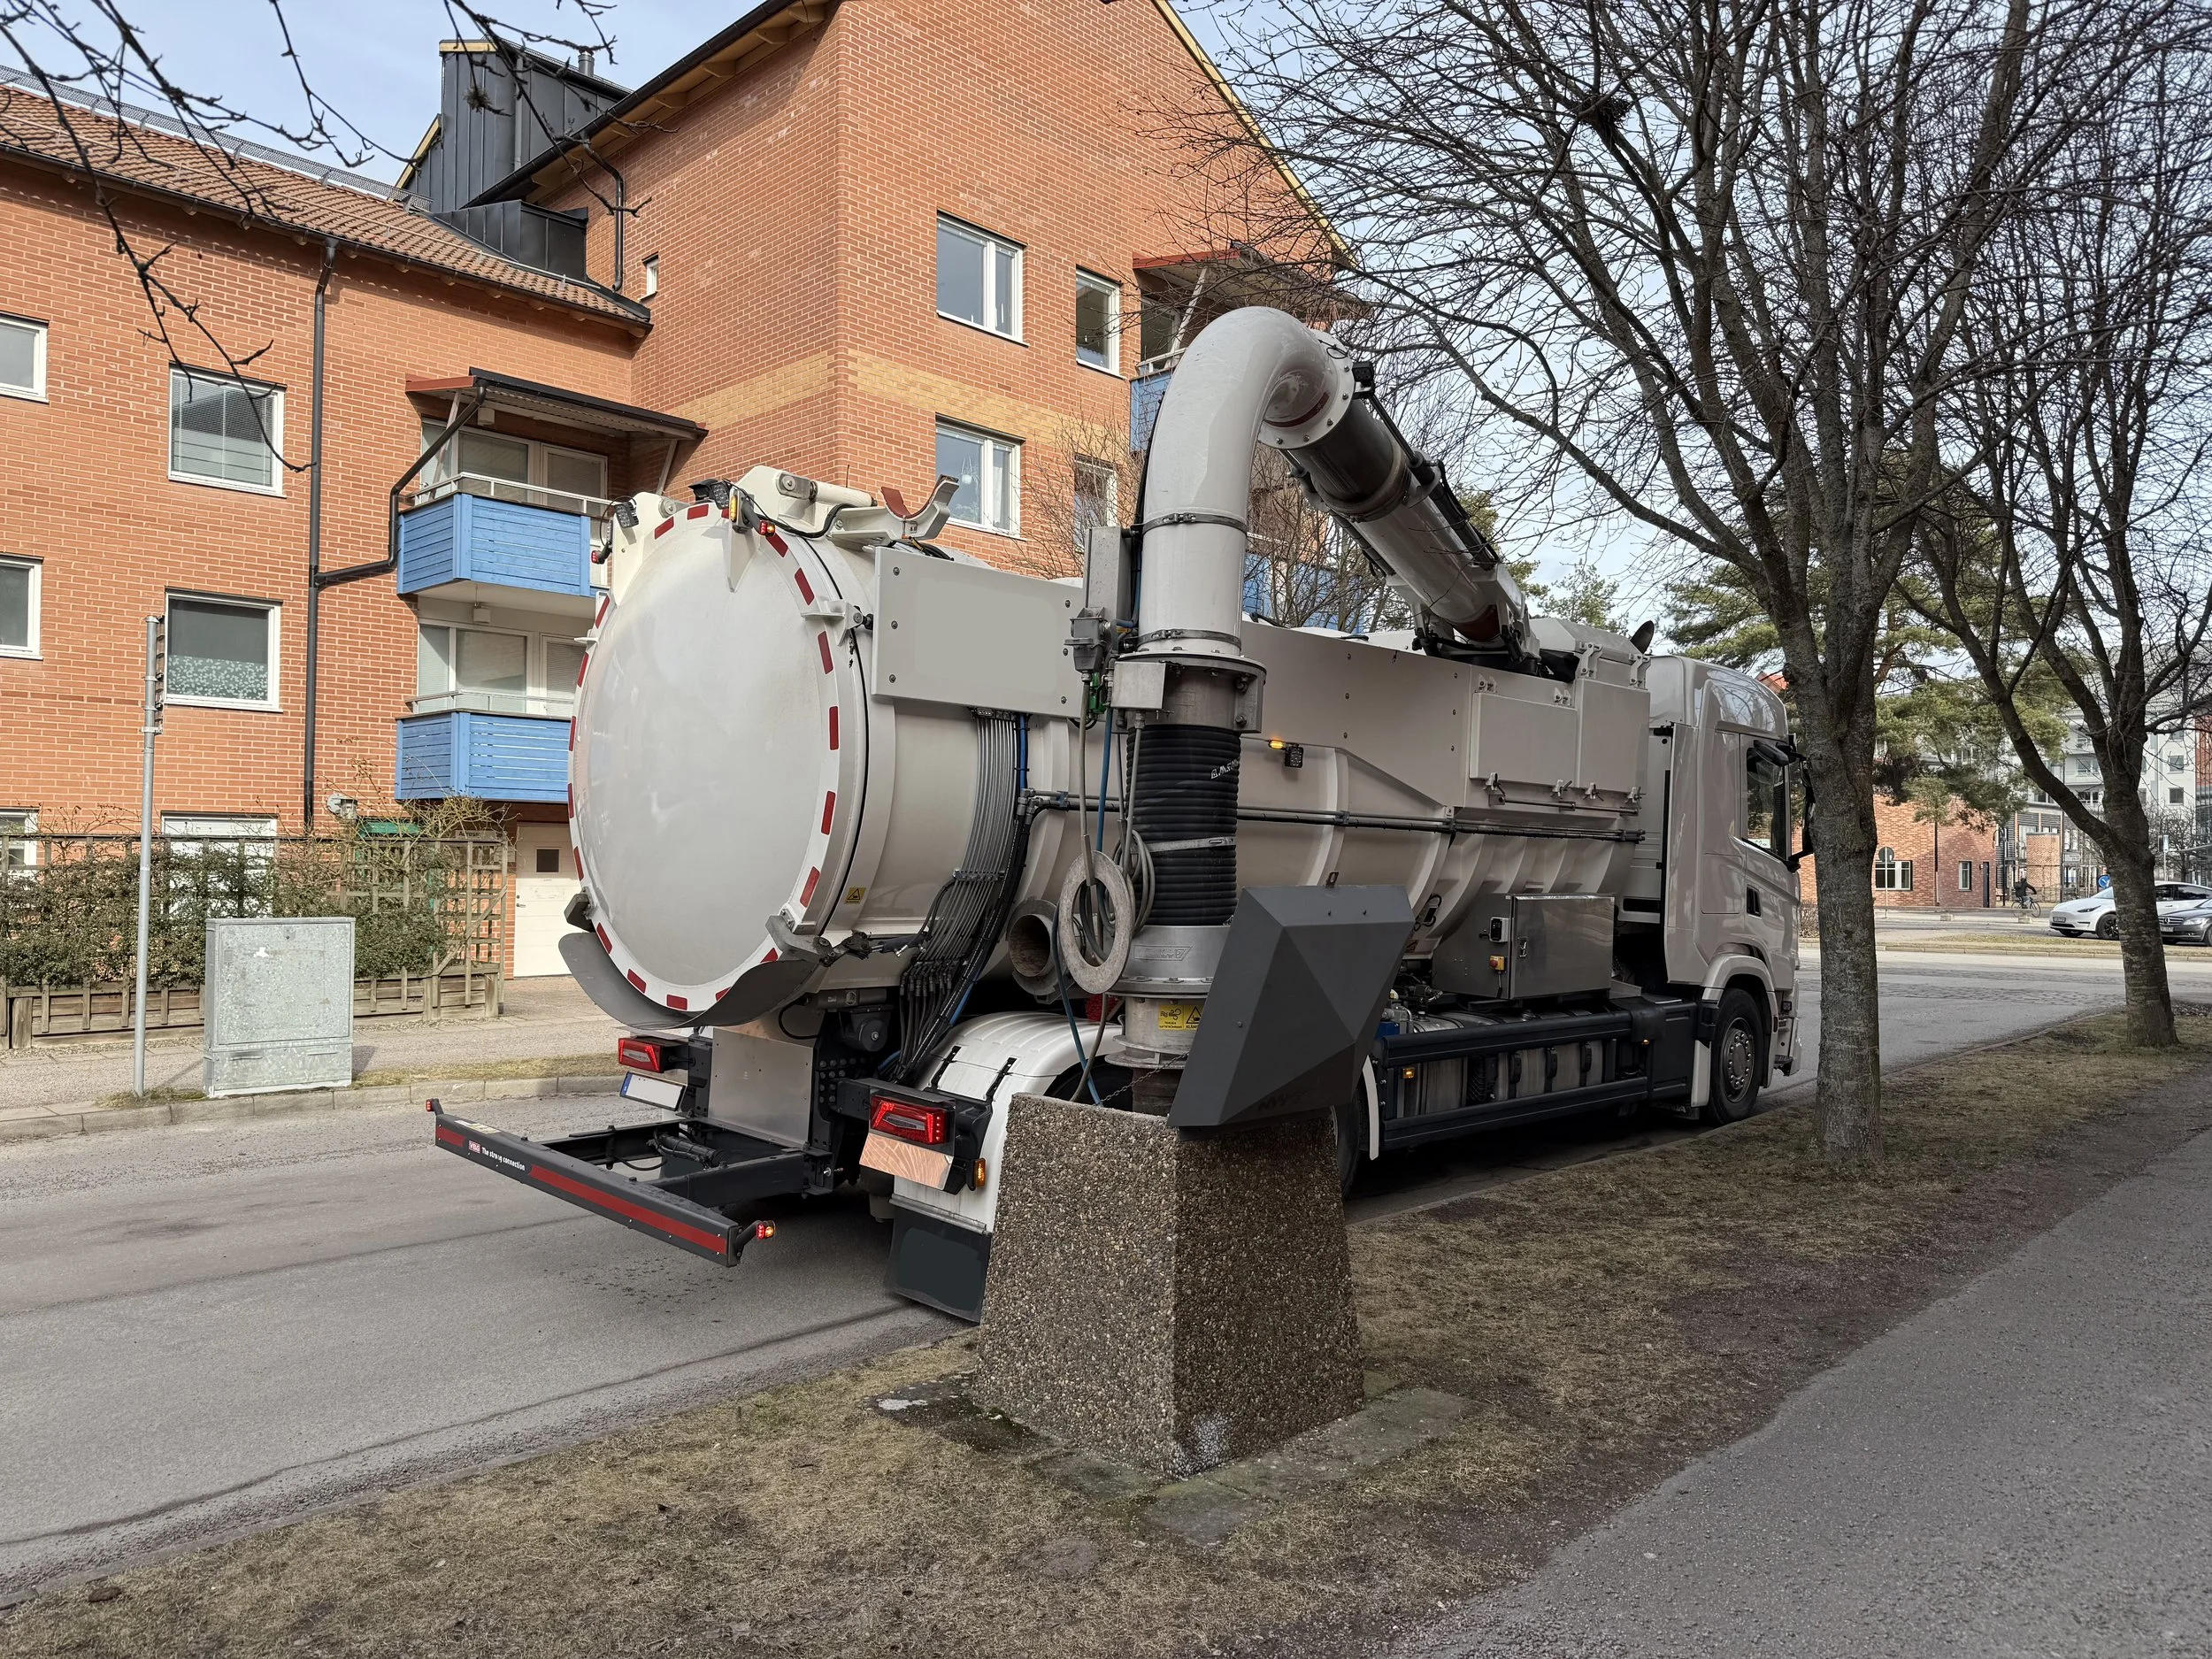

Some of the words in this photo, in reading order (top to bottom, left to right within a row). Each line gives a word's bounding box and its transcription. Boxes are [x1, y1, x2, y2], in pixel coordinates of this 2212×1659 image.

[469, 1141, 480, 1153] VBG
[489, 1151, 503, 1163] strong
[503, 1156, 526, 1171] connection
